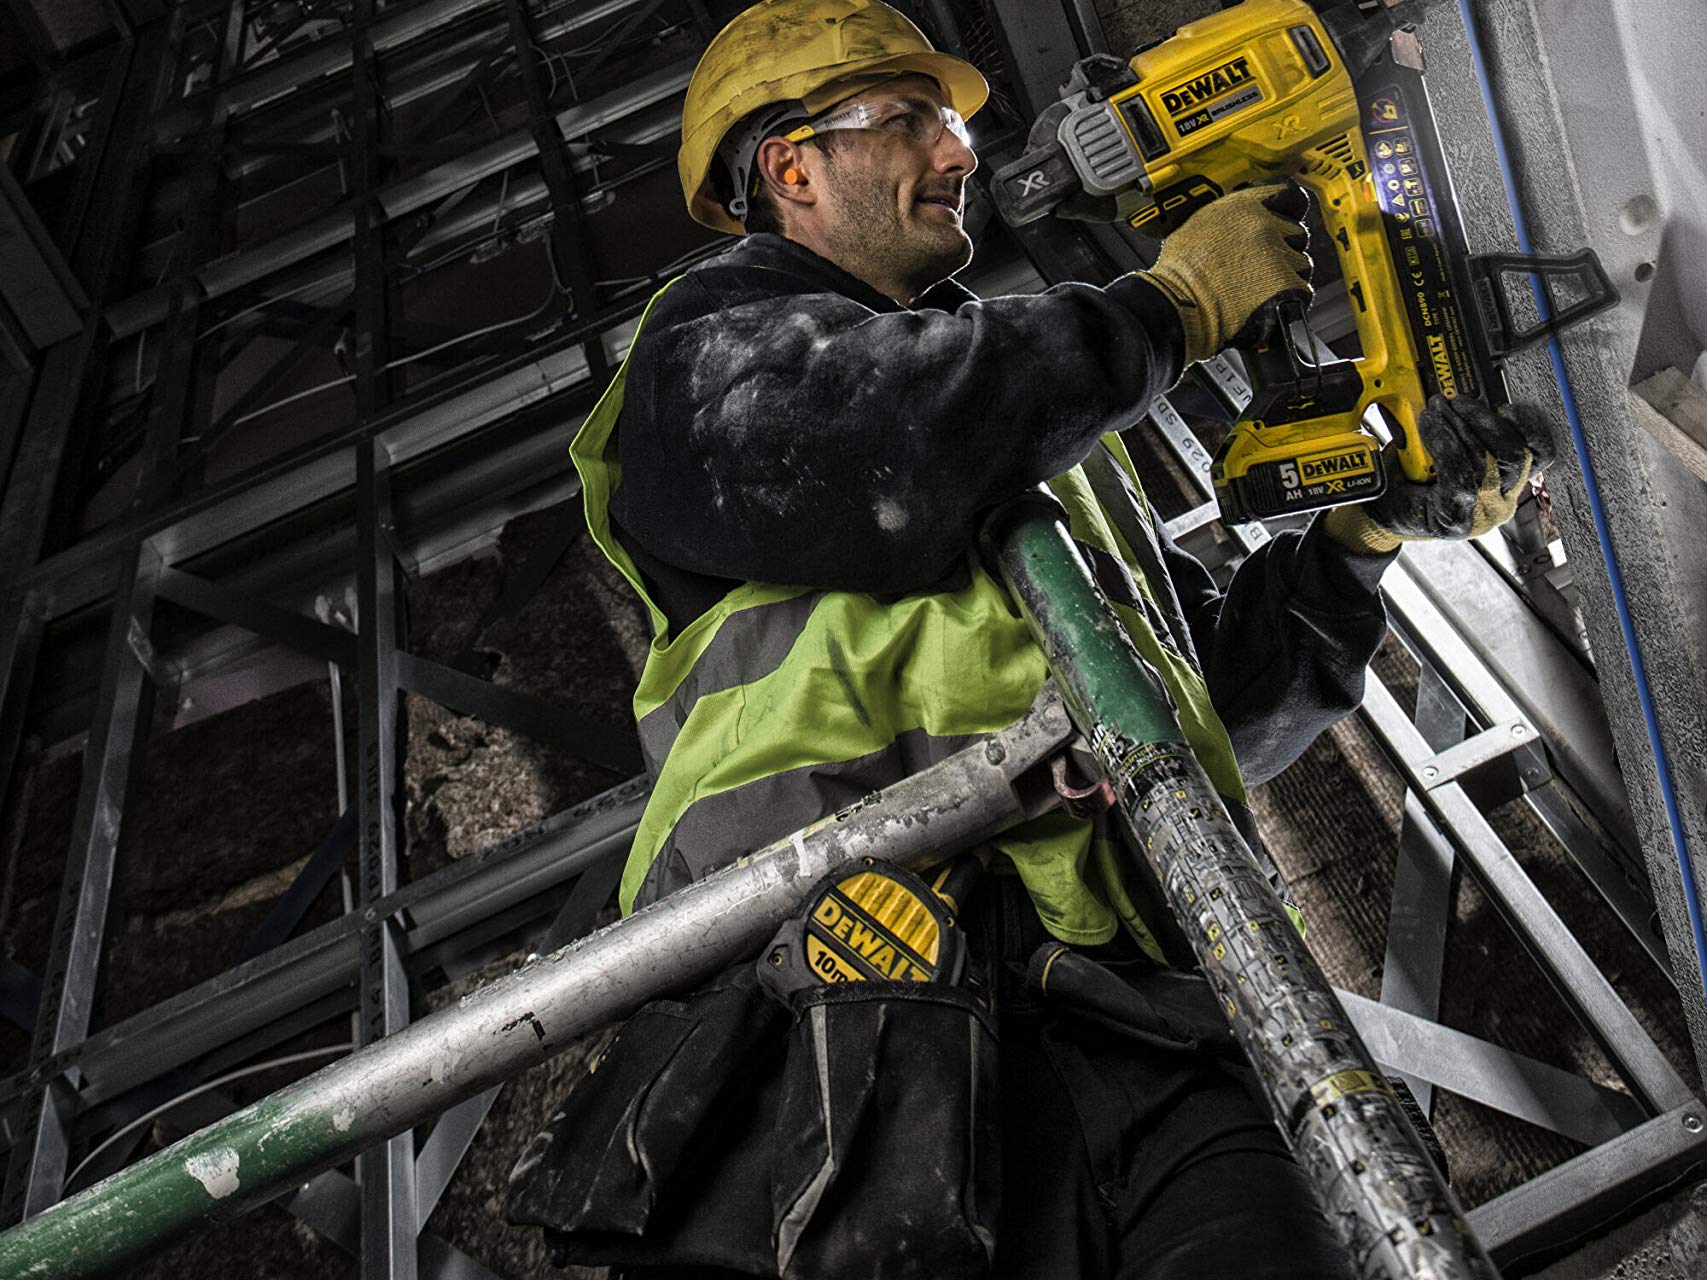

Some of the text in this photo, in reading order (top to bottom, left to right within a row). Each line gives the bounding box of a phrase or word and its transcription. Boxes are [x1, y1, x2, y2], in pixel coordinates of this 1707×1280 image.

[1160, 58, 1252, 114] DEWALT
[1178, 119, 1197, 133] 18V
[1016, 169, 1051, 198] XR
[1416, 292, 1433, 327] DCN890
[1427, 333, 1458, 400] DEWALT
[1279, 451, 1369, 489] 5 DEWALT
[1285, 488, 1303, 501] AH
[1308, 485, 1325, 497] 18V
[1326, 480, 1347, 495] XR
[813, 896, 930, 982] DEWALT
